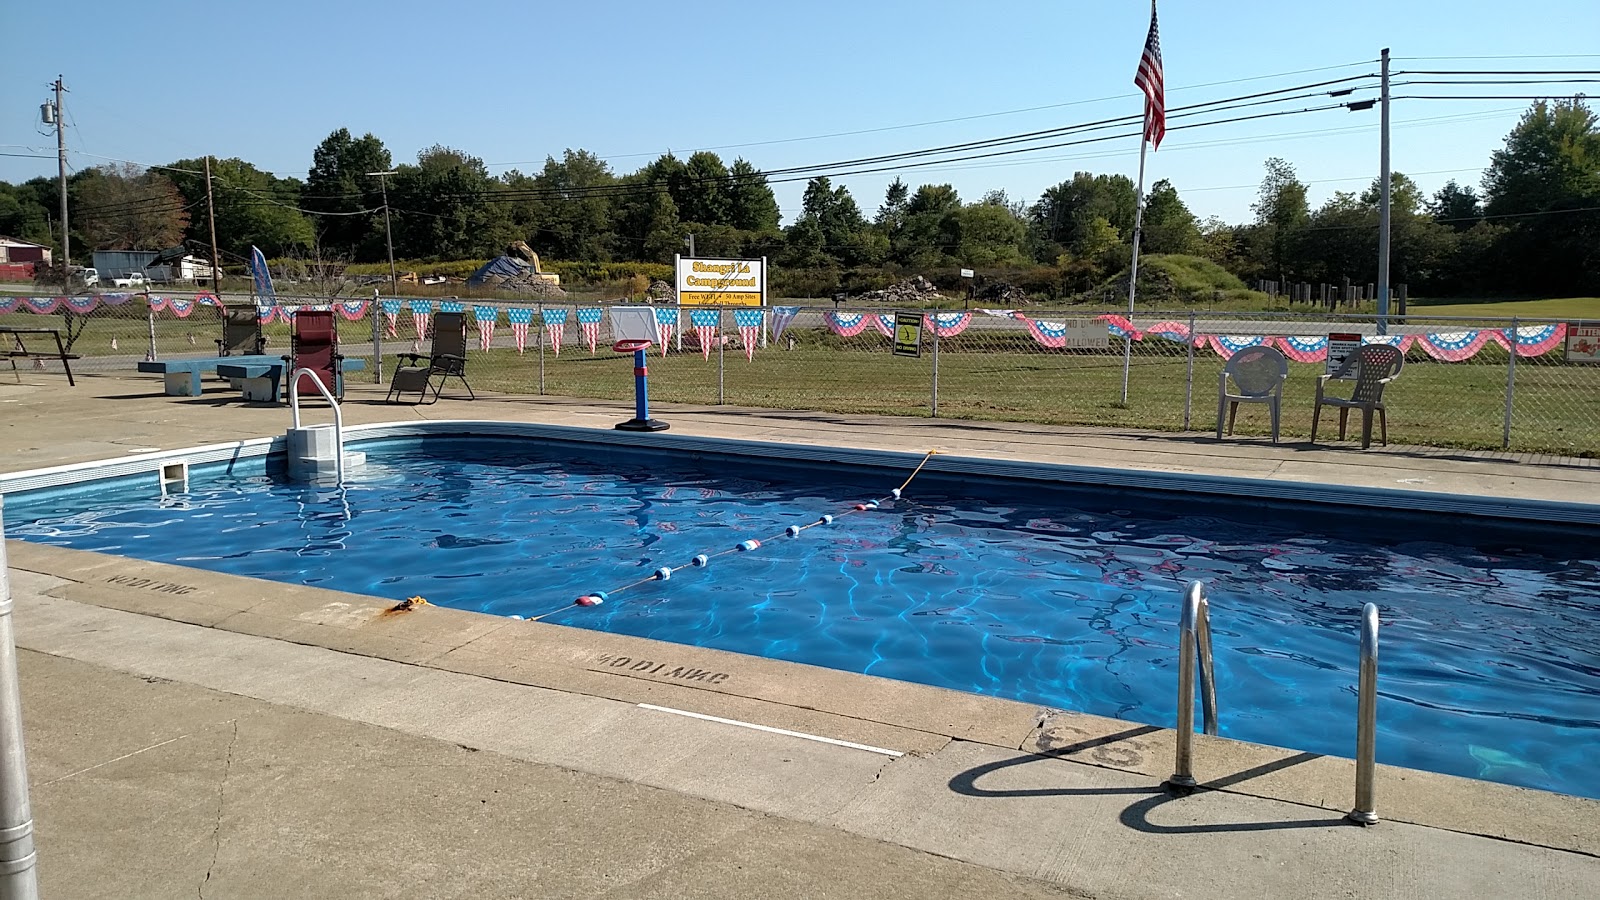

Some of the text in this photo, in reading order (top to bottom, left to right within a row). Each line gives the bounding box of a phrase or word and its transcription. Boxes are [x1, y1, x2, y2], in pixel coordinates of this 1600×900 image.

[692, 261, 735, 275] Shangri
[686, 275, 756, 289] Campground
[1066, 338, 1108, 347] ALLOWED
